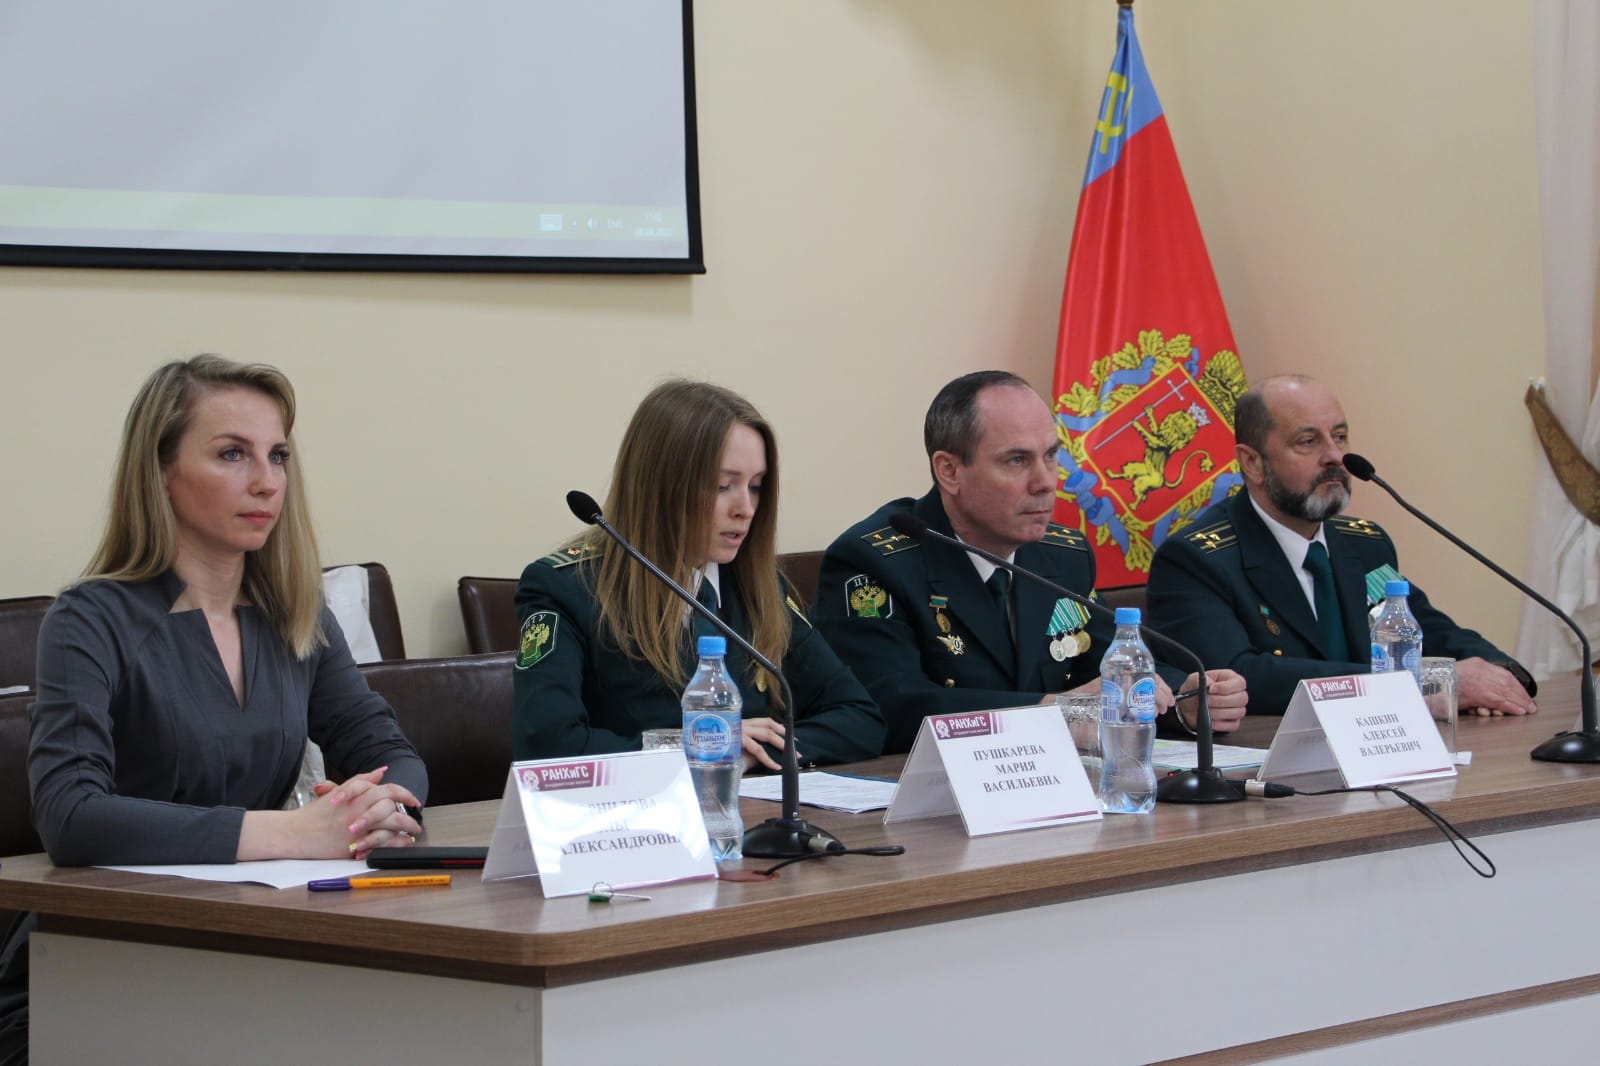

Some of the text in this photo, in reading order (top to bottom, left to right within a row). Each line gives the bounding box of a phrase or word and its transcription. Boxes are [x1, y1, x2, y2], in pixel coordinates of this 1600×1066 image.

[948, 716, 987, 730] РАНХиГС
[1355, 714, 1399, 727] КАШКИН
[1362, 727, 1406, 742] АЛЕКСЕЙ
[973, 744, 1046, 761] ПУШКАРЕВА
[1359, 741, 1421, 757] ВАЛЕРЬЕВИЧ
[541, 765, 589, 781] РАНХиГС
[995, 761, 1036, 775] МАРИЯ
[983, 776, 1061, 793] ВАСИЛЬЕВНА
[561, 833, 680, 856] АЛЕКСАНДРОВН
